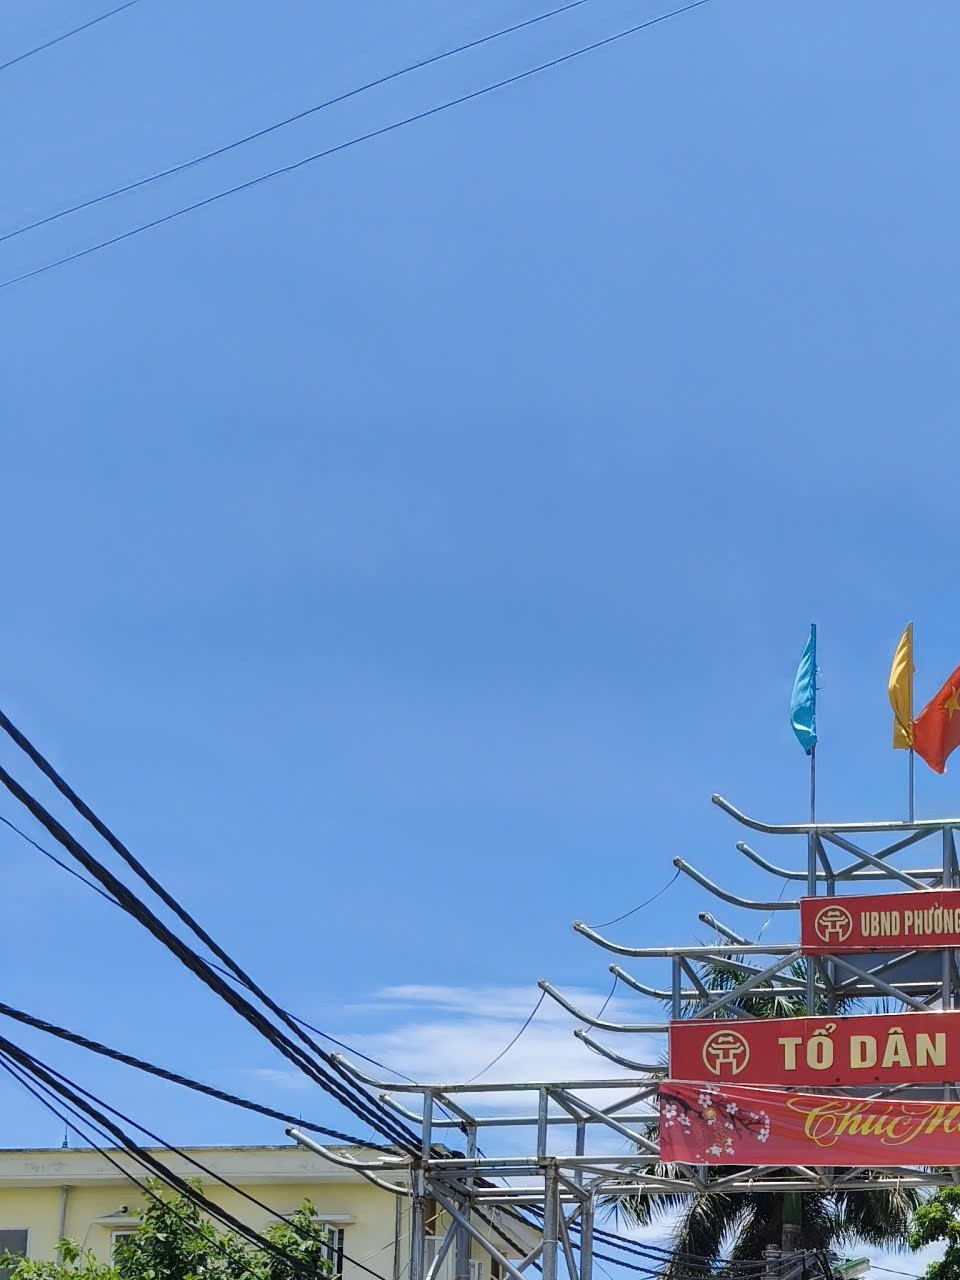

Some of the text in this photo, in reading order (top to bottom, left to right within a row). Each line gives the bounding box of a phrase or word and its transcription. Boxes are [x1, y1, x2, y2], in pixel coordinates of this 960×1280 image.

[860, 911, 900, 937] UBND
[778, 1022, 838, 1071] TỔ
[850, 1026, 947, 1069] DÂN
[786, 1097, 912, 1147] Chúc
